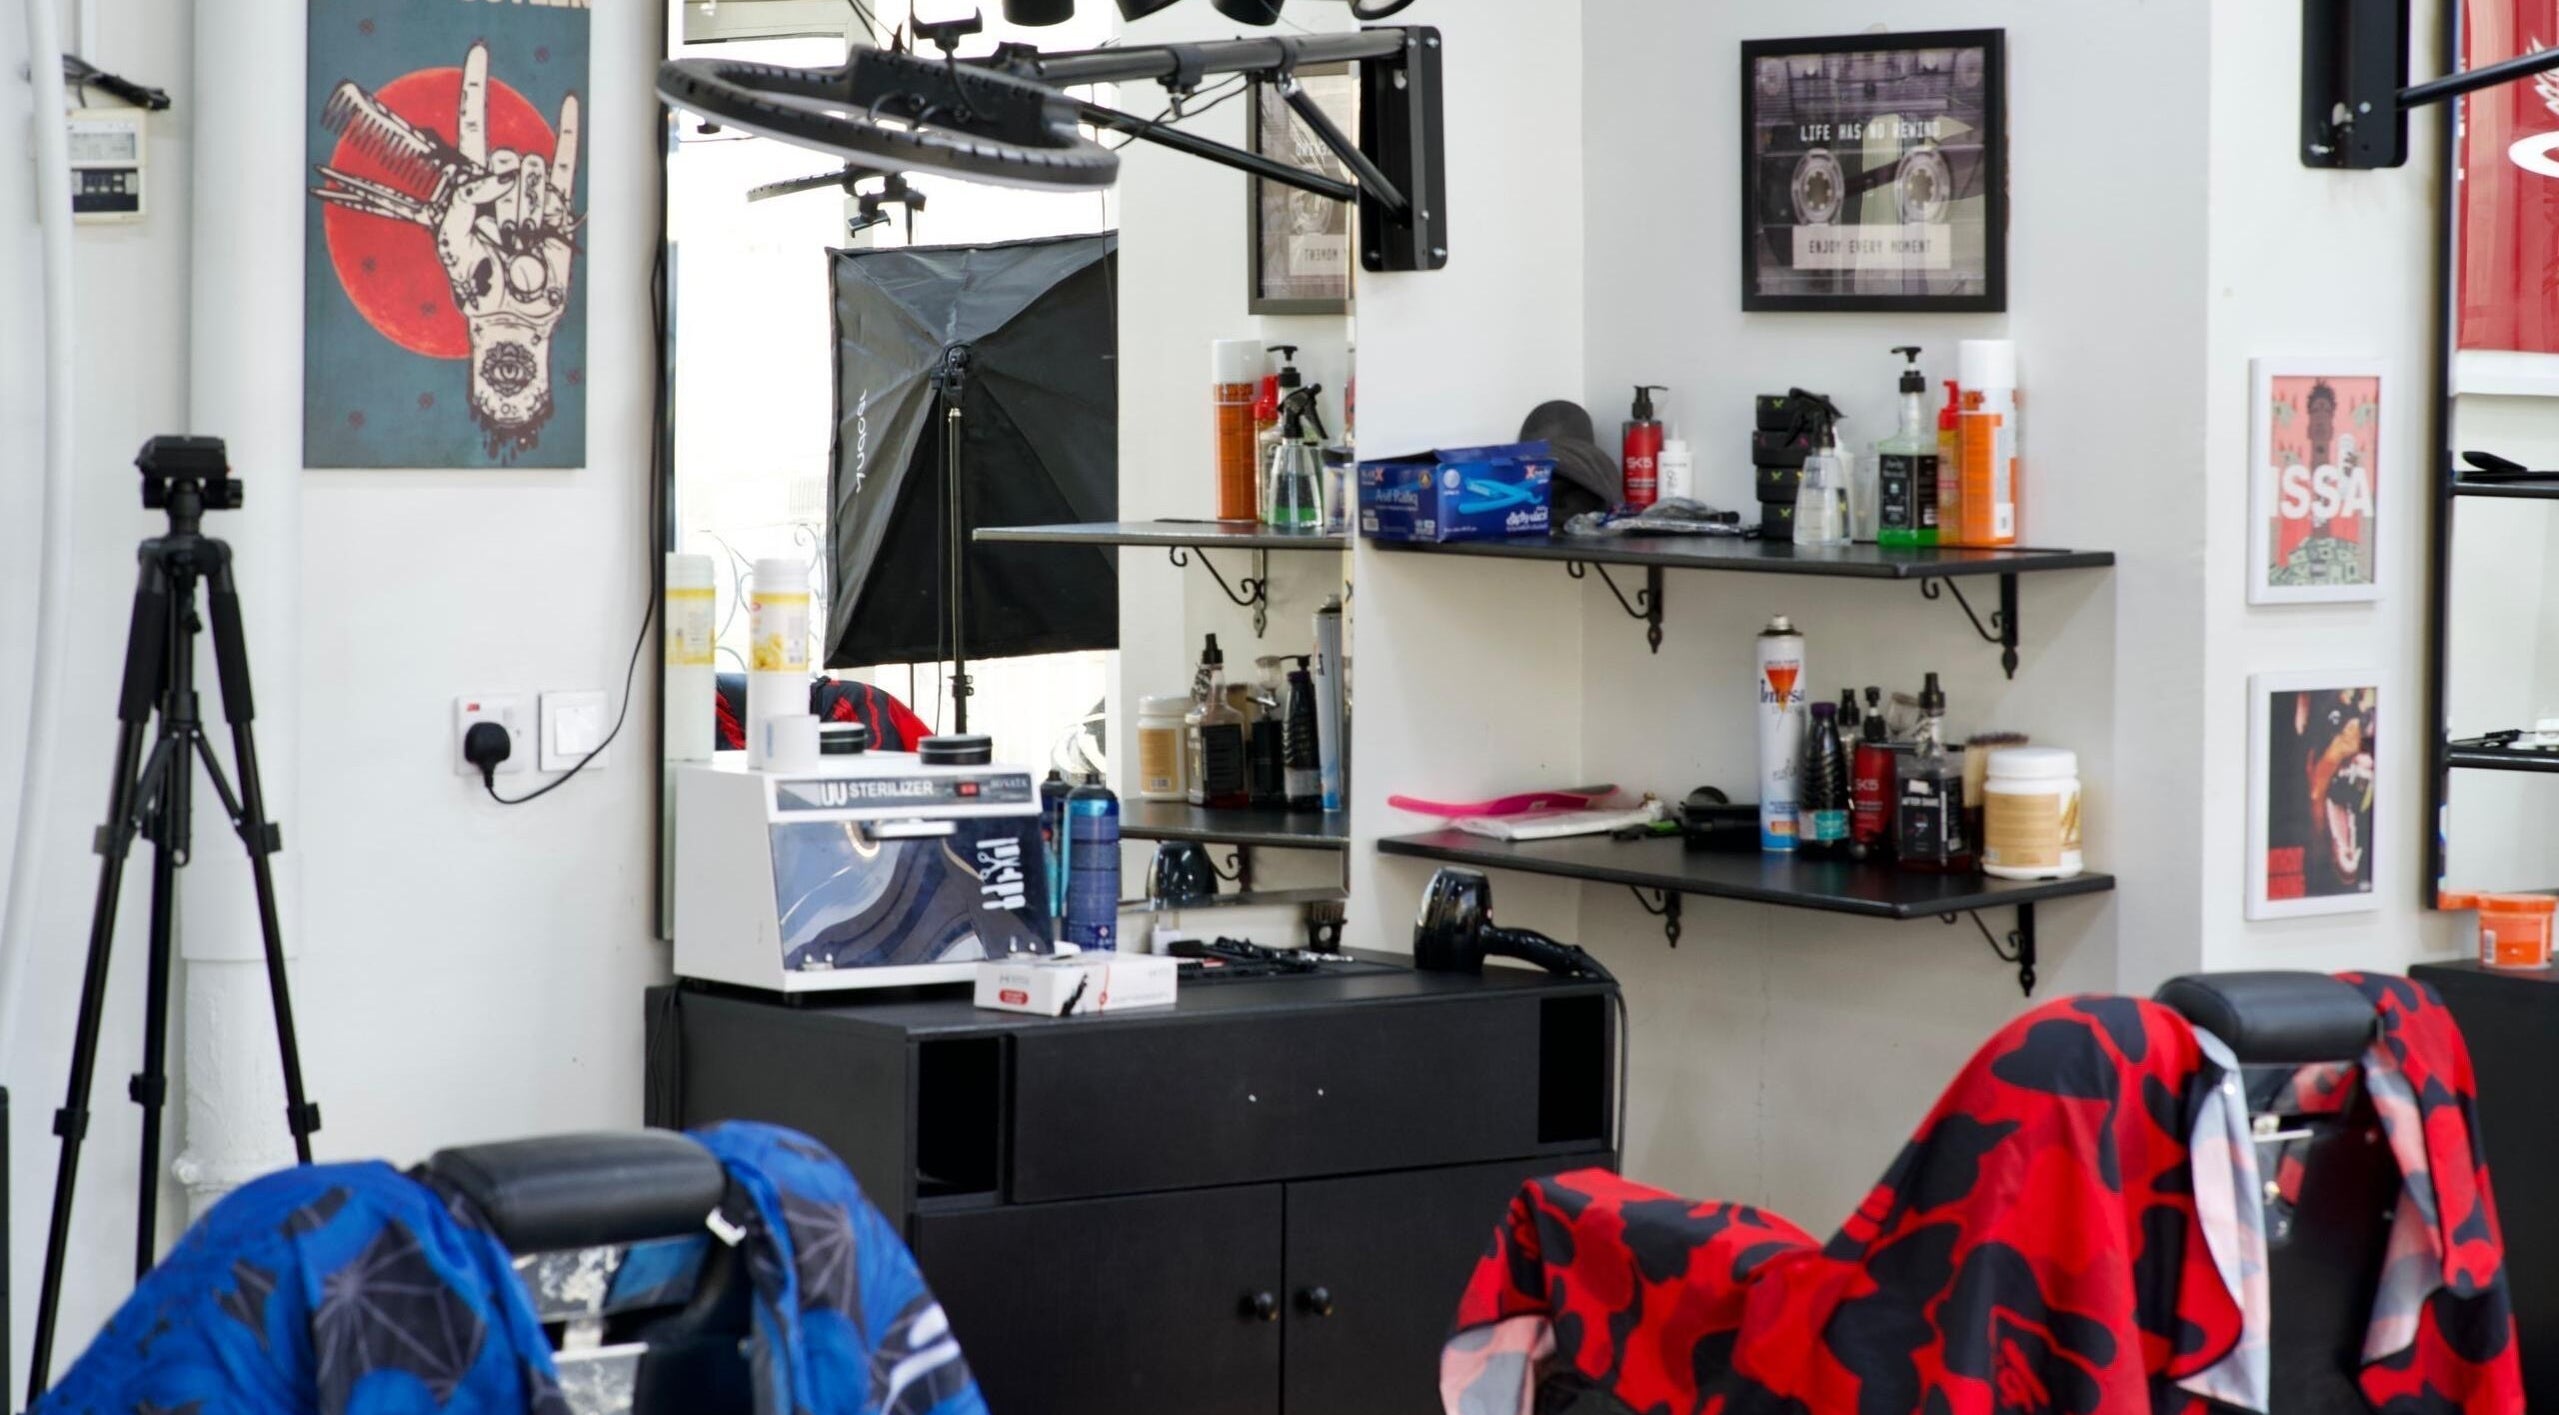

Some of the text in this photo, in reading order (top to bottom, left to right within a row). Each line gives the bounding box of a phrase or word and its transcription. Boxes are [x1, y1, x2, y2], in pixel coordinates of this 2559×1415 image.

[1800, 120, 1941, 142] LIFE HAS NO REWIND
[1809, 239, 1930, 254] ENJOY EVERY MOMENT
[2267, 463, 2374, 520] ISSA
[849, 780, 934, 798] STERILIZER
